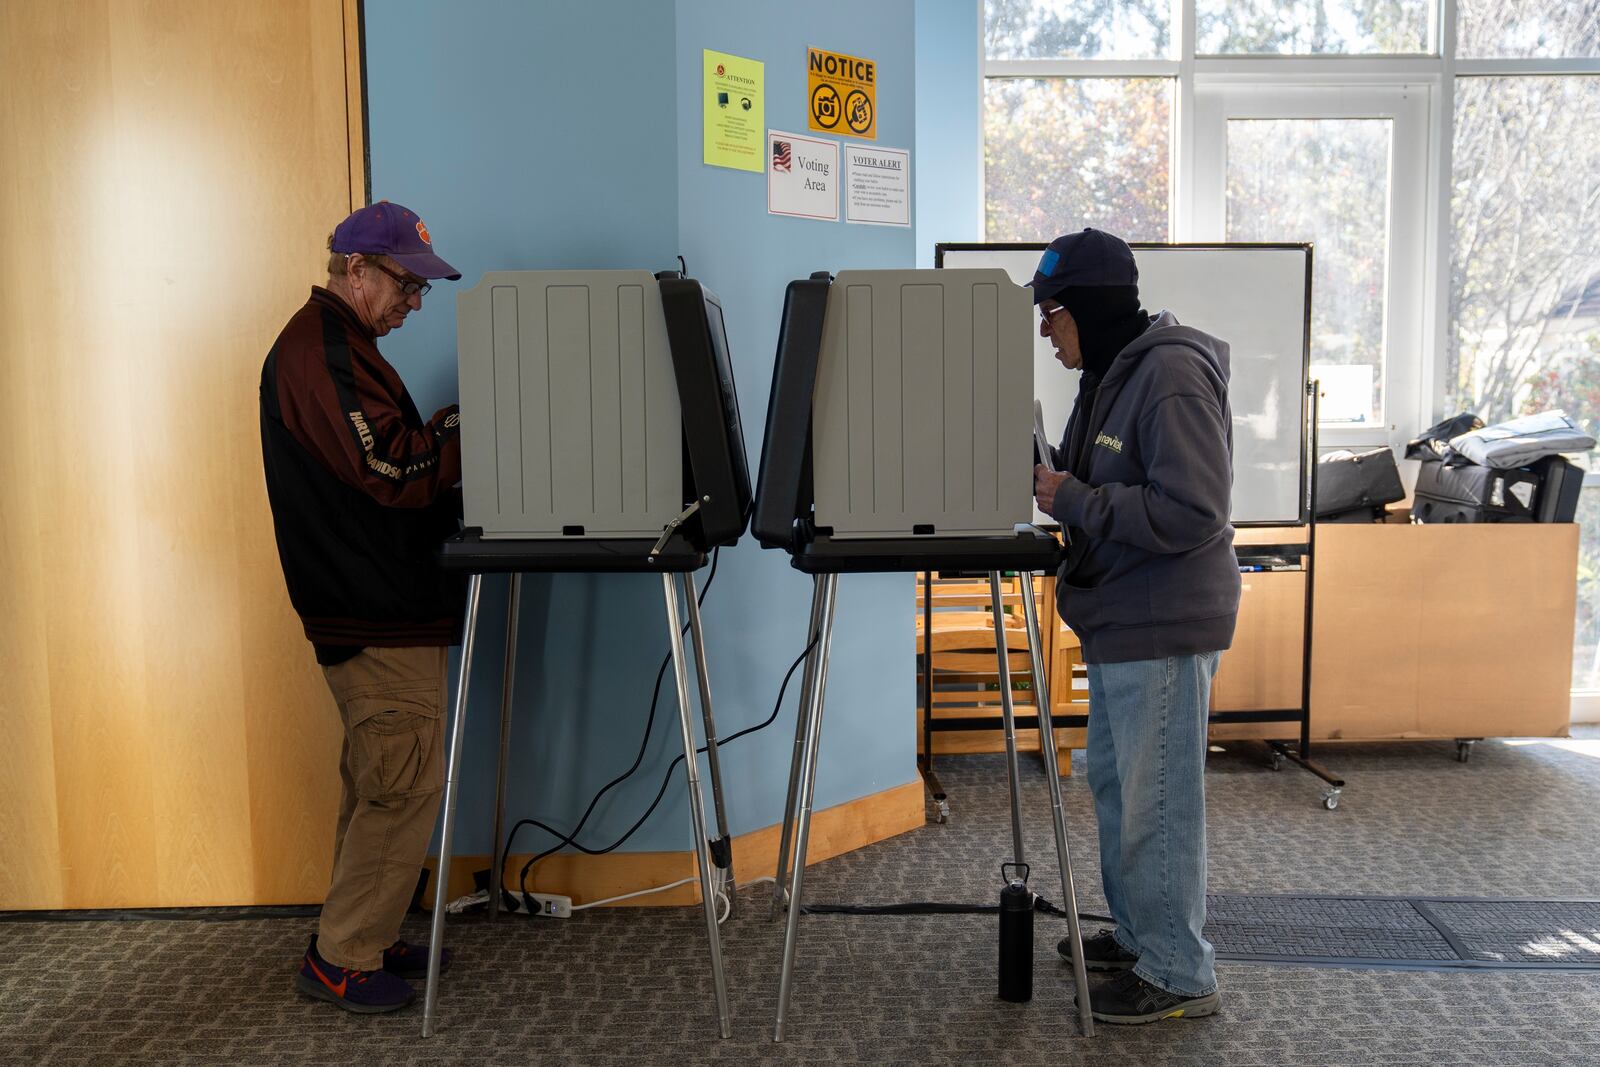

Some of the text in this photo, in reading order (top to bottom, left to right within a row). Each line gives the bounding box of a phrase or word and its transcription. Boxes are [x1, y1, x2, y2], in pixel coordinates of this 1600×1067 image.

[810, 51, 873, 82] NOTICE
[726, 74, 755, 85] ATTENTION
[798, 156, 829, 176] Voting
[853, 155, 902, 169] VOTER ALERT
[804, 177, 826, 192] Area
[366, 451, 402, 480] DAVIDSO
